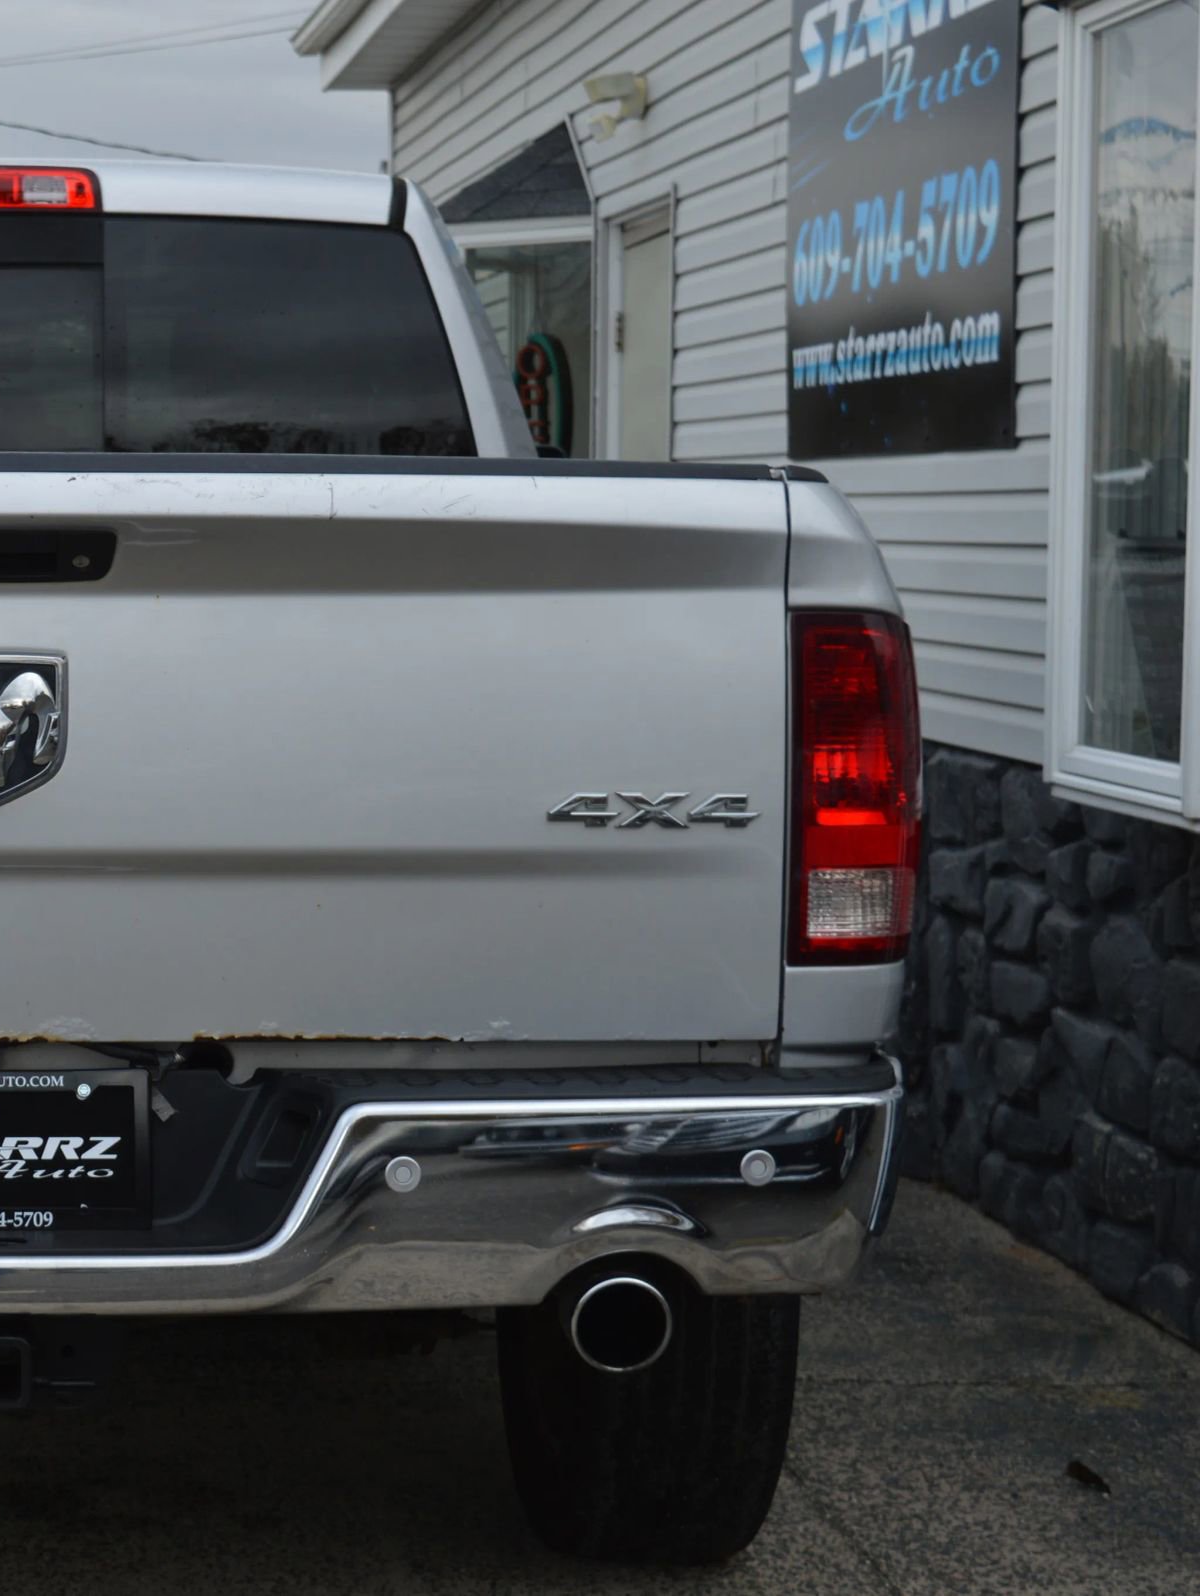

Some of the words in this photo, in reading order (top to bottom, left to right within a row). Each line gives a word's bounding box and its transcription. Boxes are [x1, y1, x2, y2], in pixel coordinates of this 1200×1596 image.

[794, 0, 997, 94] STAR
[843, 44, 1001, 141] Auto
[793, 159, 1000, 305] 609-704-5709
[793, 310, 999, 389] www.starrzauto.com
